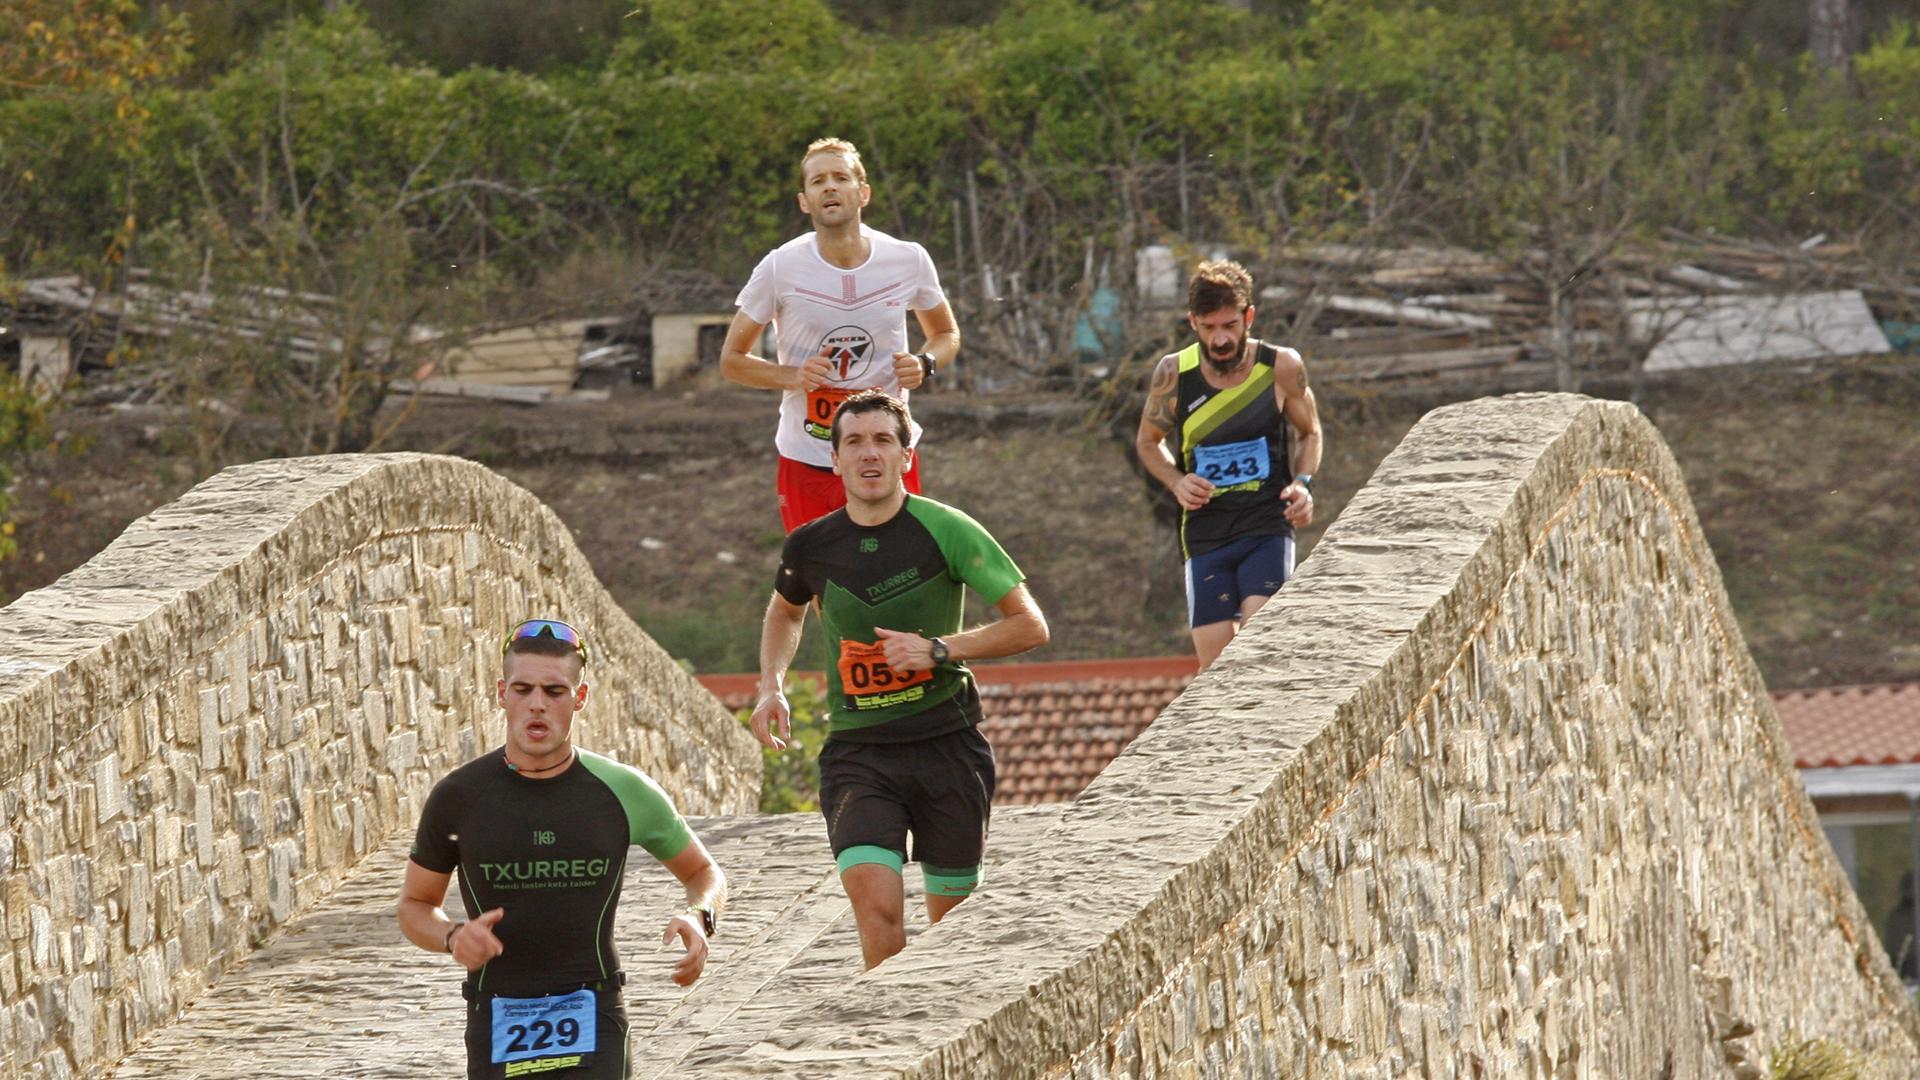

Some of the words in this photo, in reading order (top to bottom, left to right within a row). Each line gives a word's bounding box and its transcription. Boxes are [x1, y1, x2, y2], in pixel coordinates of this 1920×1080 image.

[1205, 457, 1260, 481] 243
[865, 567, 920, 597] TXURREGI
[479, 857, 610, 880] TXURREGI
[505, 1018, 580, 1053] 229
